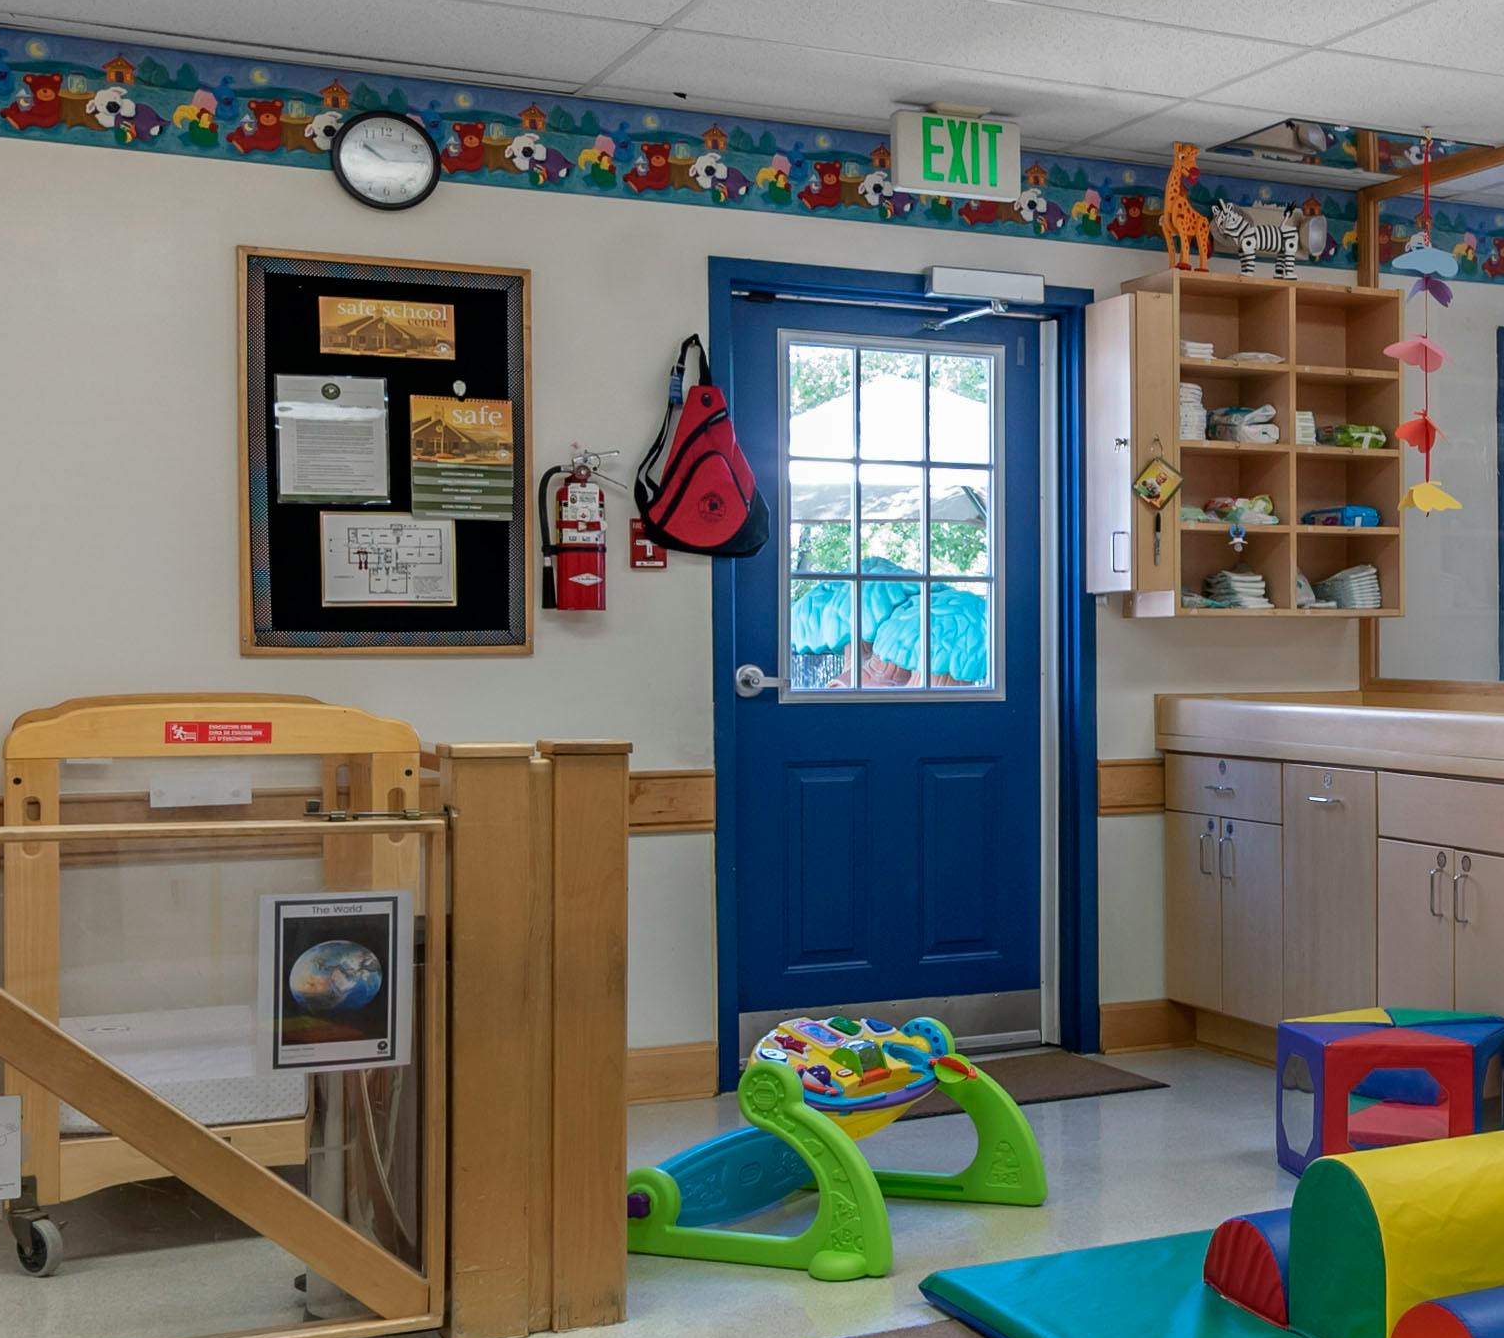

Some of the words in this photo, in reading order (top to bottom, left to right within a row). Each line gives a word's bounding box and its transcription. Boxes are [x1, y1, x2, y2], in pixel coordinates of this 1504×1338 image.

[365, 129, 375, 139] 11
[380, 127, 392, 137] 12
[922, 116, 1003, 187] EXIT
[337, 300, 377, 317] safe
[383, 305, 447, 321] school
[407, 317, 447, 328] center
[452, 406, 503, 426] safe
[311, 905, 330, 915] The
[332, 904, 362, 914] World
